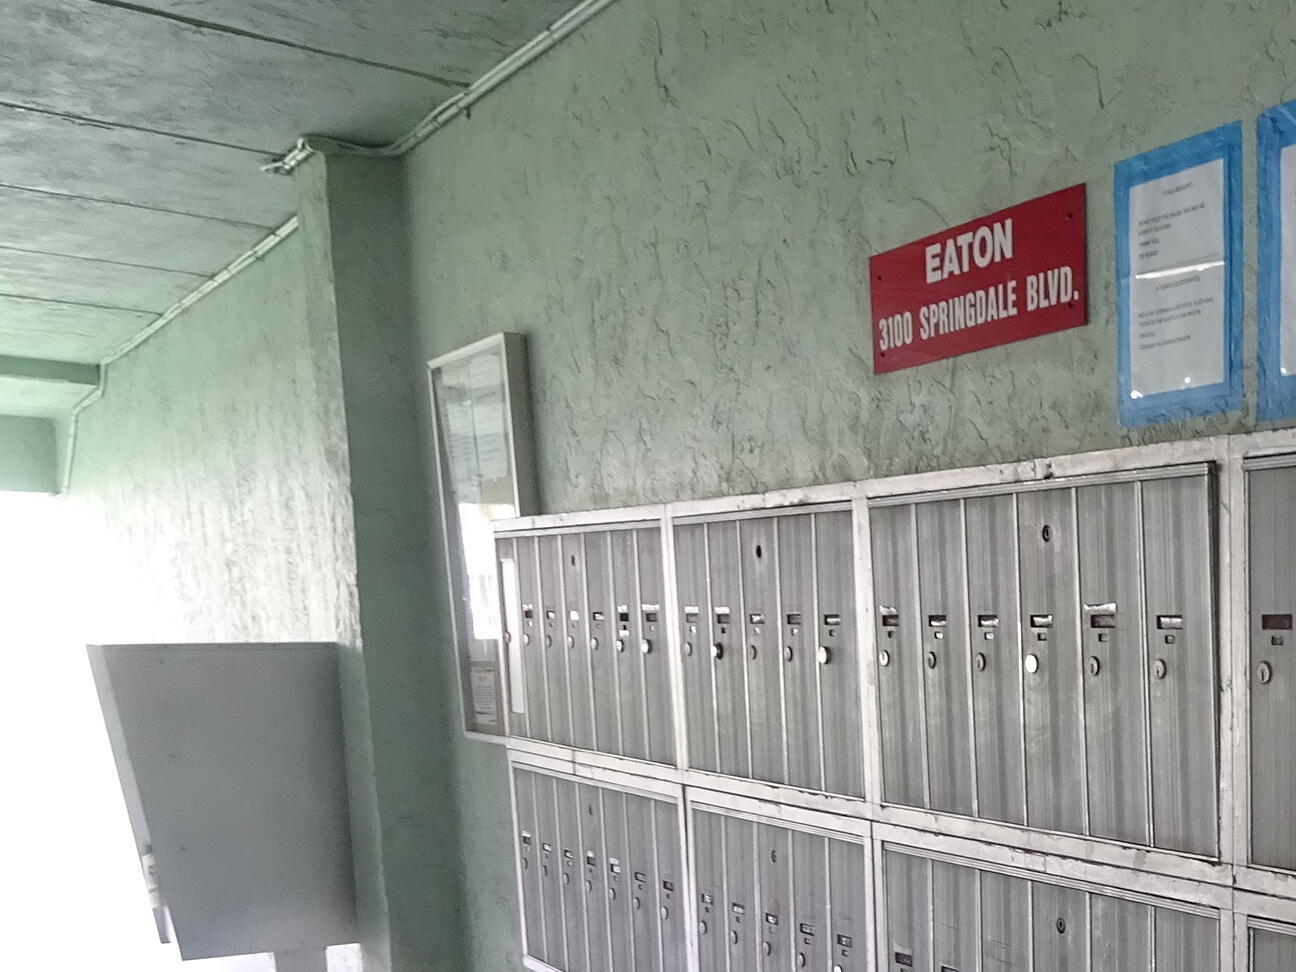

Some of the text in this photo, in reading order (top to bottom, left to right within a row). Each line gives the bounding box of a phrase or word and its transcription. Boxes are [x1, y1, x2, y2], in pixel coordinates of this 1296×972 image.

[925, 218, 1013, 284] EATON
[879, 265, 1080, 351] 3100 SPRINGDALE BLVD.
